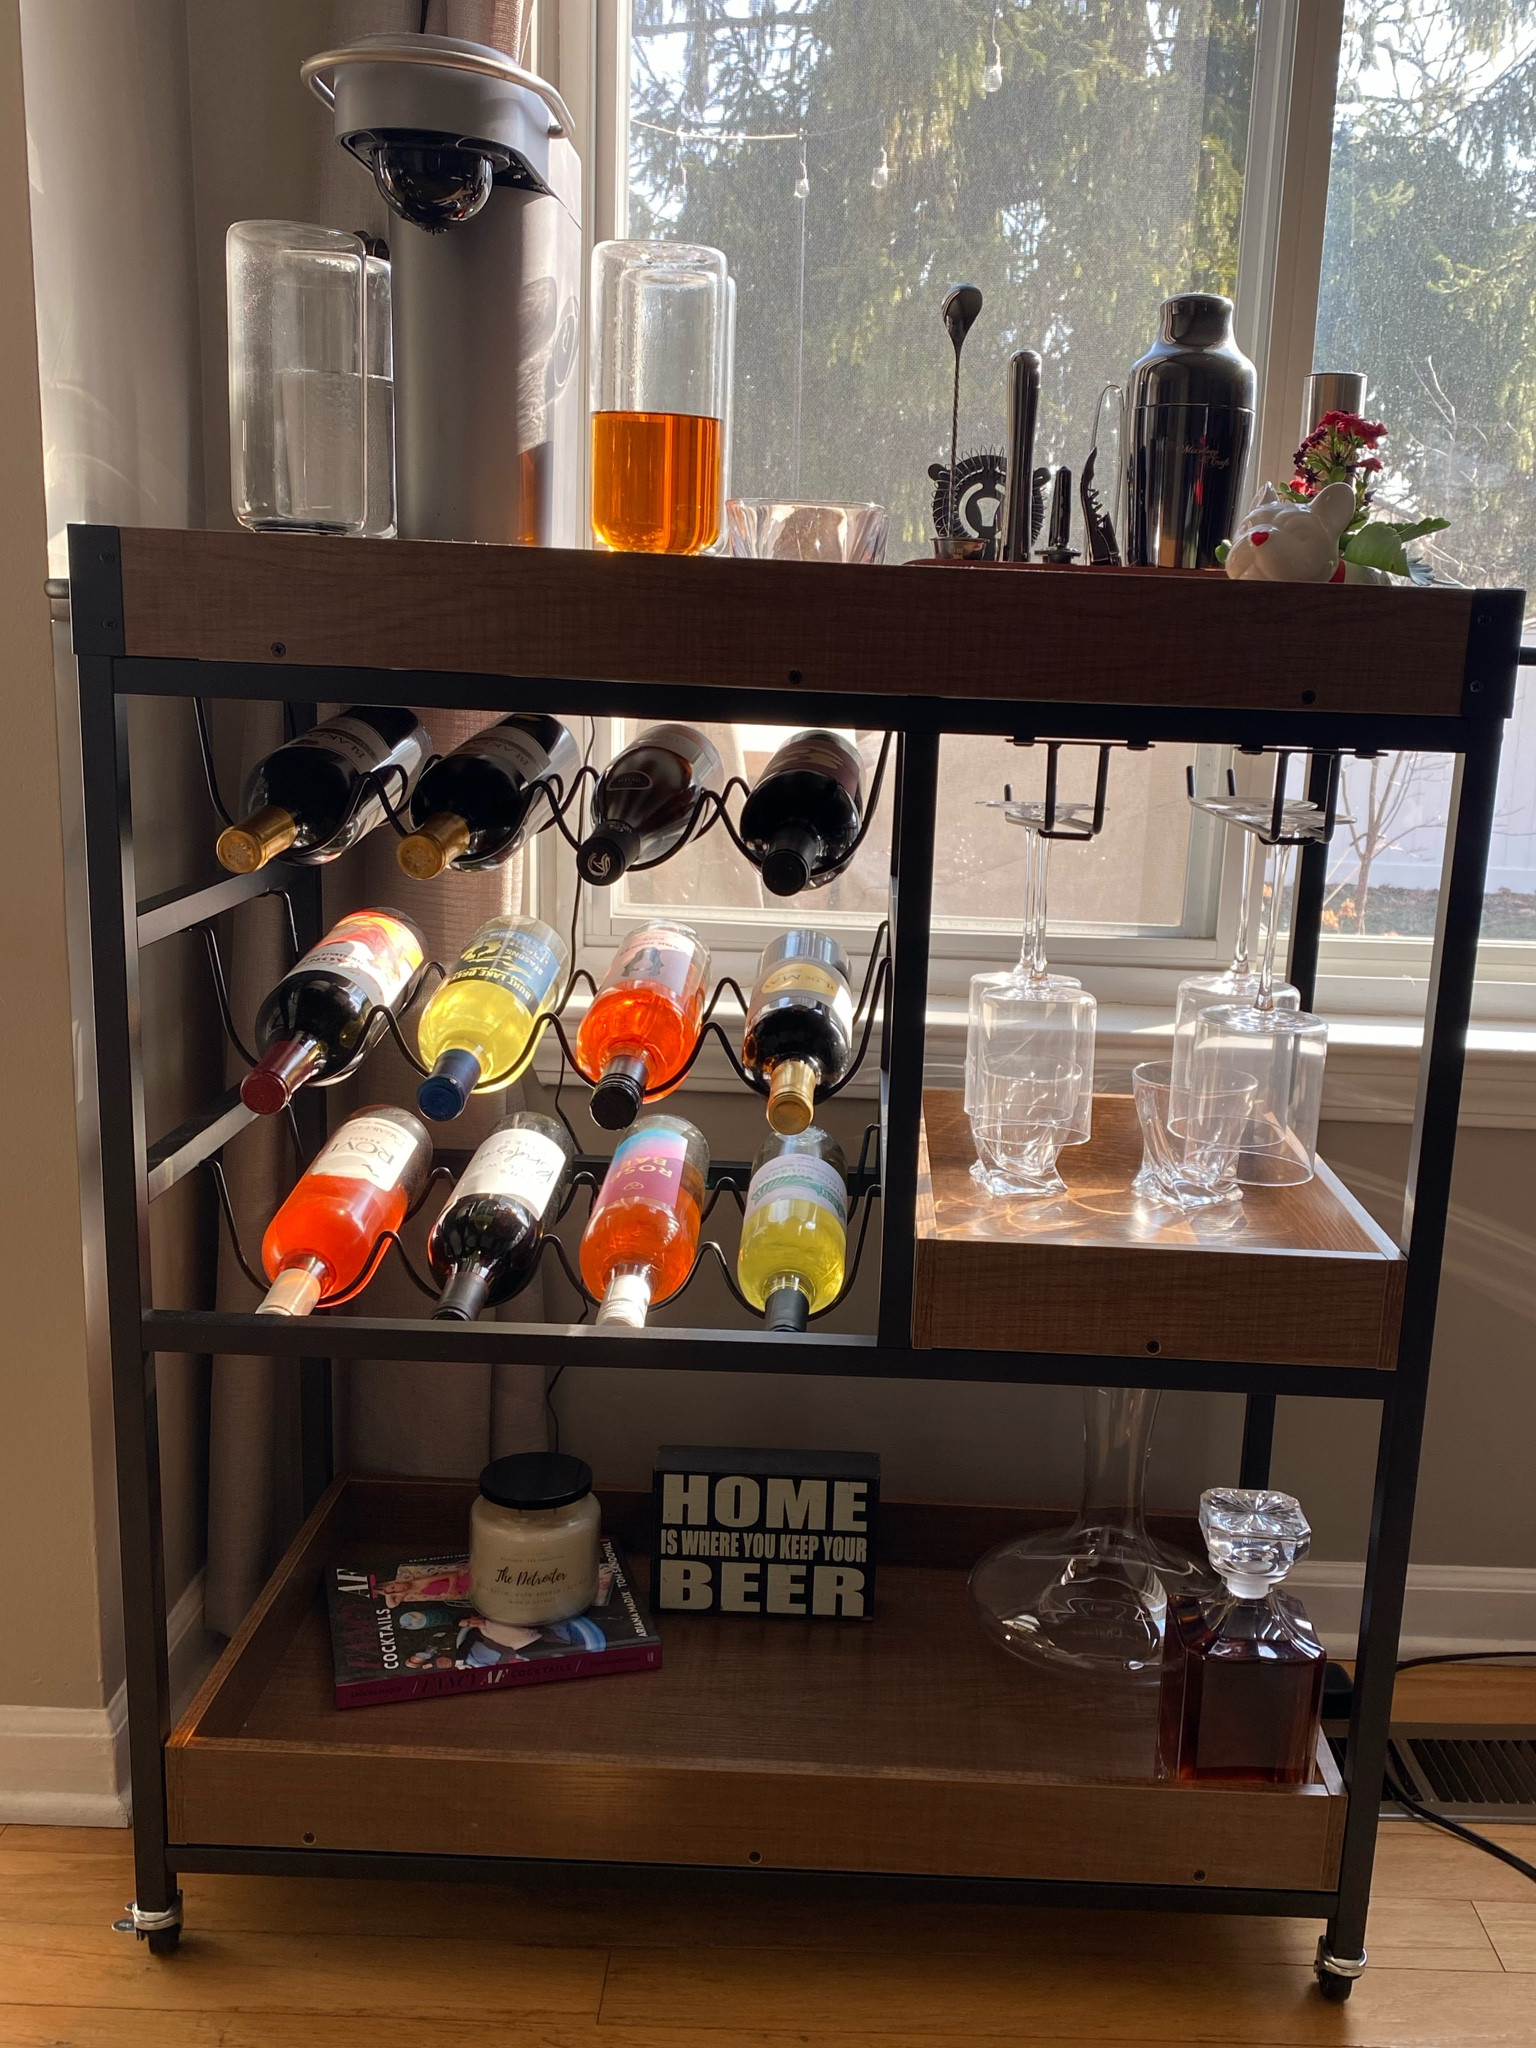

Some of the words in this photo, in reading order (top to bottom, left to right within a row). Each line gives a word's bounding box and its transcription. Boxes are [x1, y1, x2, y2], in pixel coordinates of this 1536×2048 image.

[479, 969, 507, 984] LAKE
[506, 977, 534, 1001] BURT
[662, 1474, 868, 1532] HOME
[602, 1541, 623, 1575] SANDOVAL
[660, 1529, 678, 1555] IS
[681, 1530, 739, 1557] WHERE
[743, 1532, 776, 1559] YOU
[780, 1534, 819, 1561] KEEP
[822, 1535, 867, 1563] YOUR
[336, 1568, 371, 1599] AF
[495, 1566, 513, 1585] The
[516, 1567, 567, 1587] Detroiter
[614, 1572, 628, 1588] TOM
[659, 1559, 866, 1617] BEER
[621, 1591, 639, 1613] MADIX
[629, 1612, 649, 1638] ARIANA
[376, 1608, 399, 1670] COCKTAILS
[511, 1665, 573, 1679] COCKTAILS
